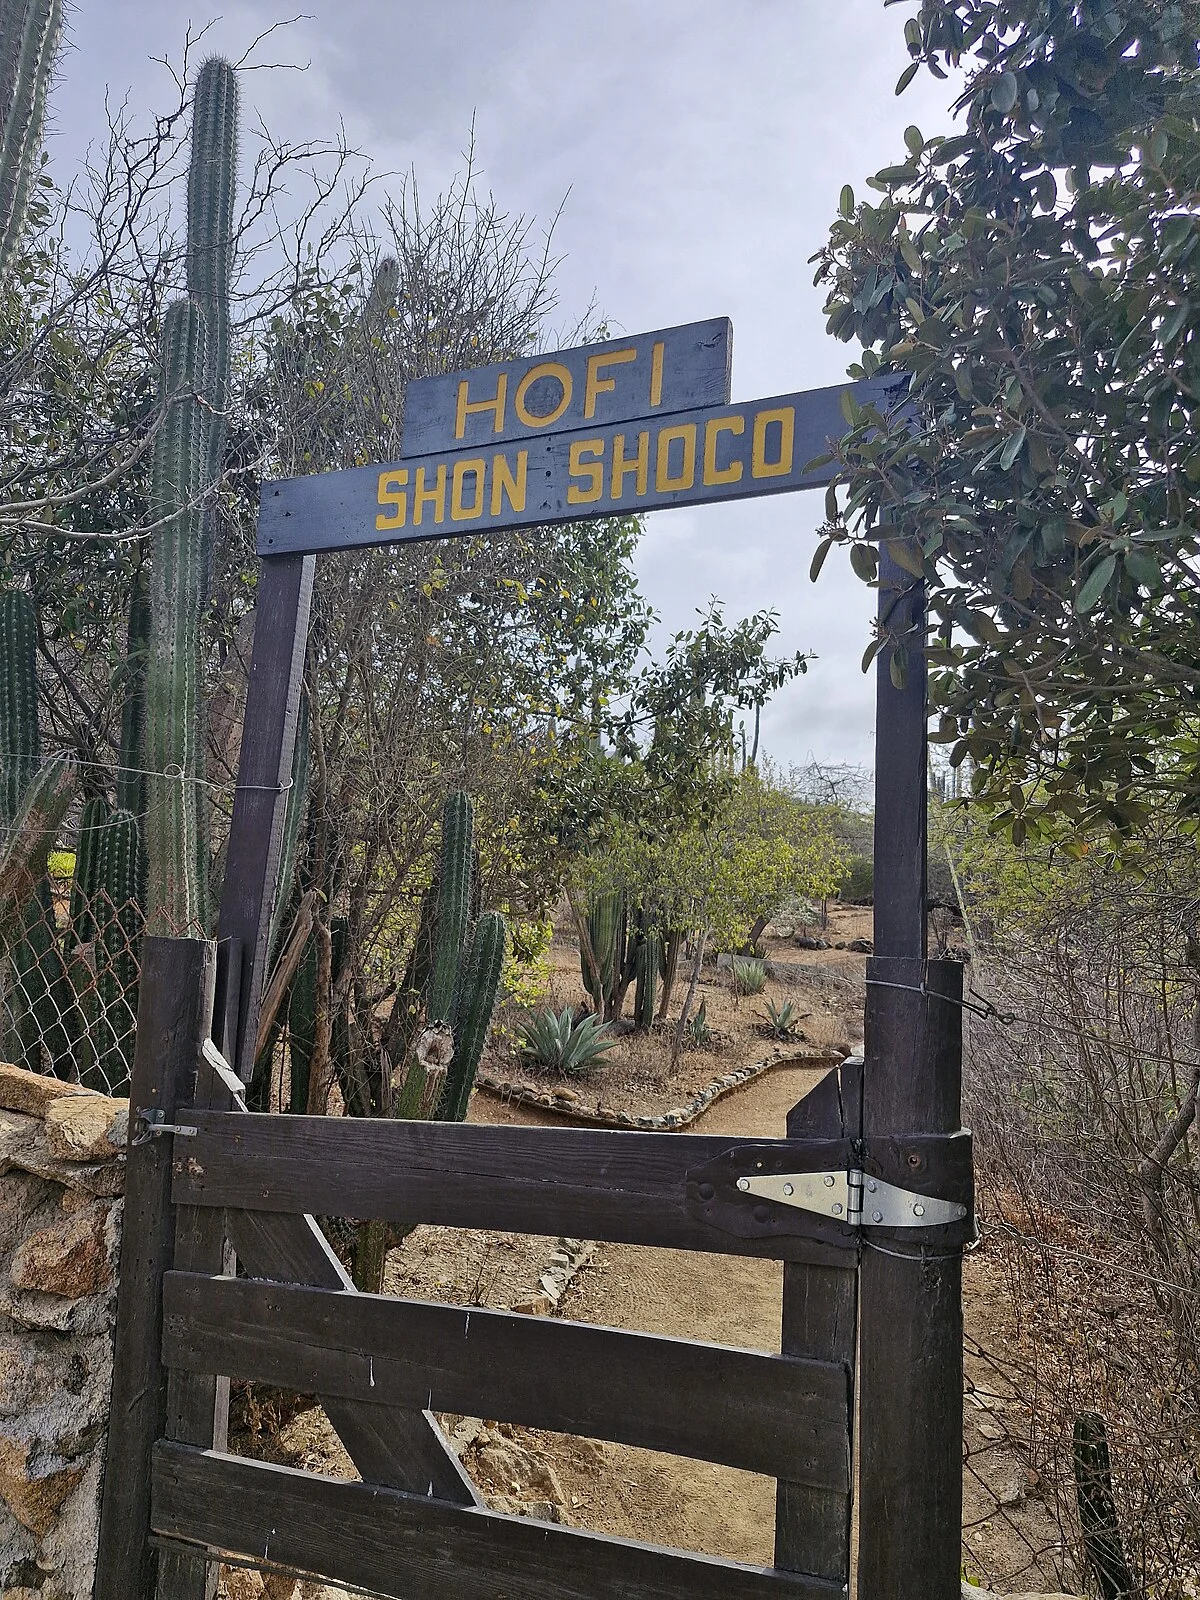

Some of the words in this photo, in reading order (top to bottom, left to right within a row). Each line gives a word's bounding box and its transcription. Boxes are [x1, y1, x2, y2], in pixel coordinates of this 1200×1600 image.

[455, 341, 665, 440] HOFI
[375, 450, 528, 531] SHON
[567, 406, 795, 505] SHOCO
